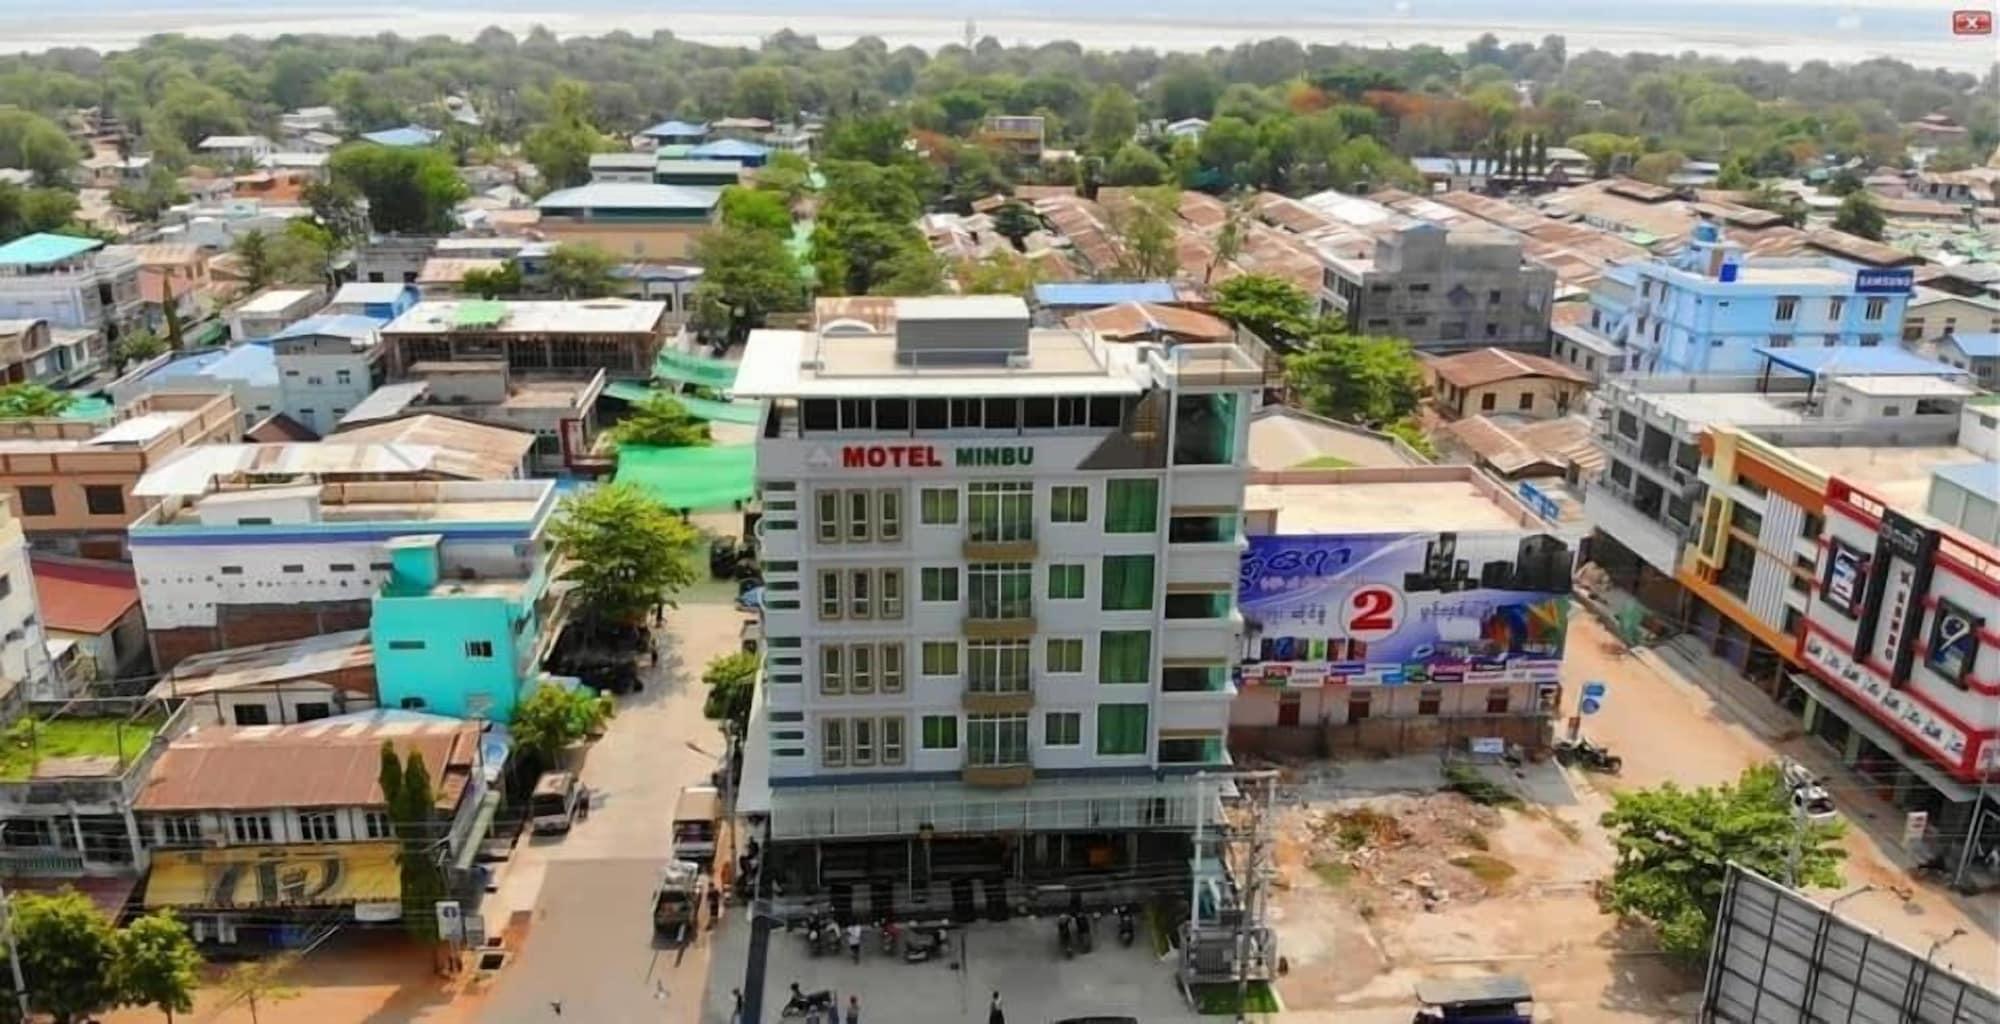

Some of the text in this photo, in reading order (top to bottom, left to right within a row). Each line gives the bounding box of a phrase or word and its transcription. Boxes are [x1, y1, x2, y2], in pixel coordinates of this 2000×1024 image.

[843, 446, 1034, 468] MOTEL MINBU
[1349, 590, 1393, 630] 2
